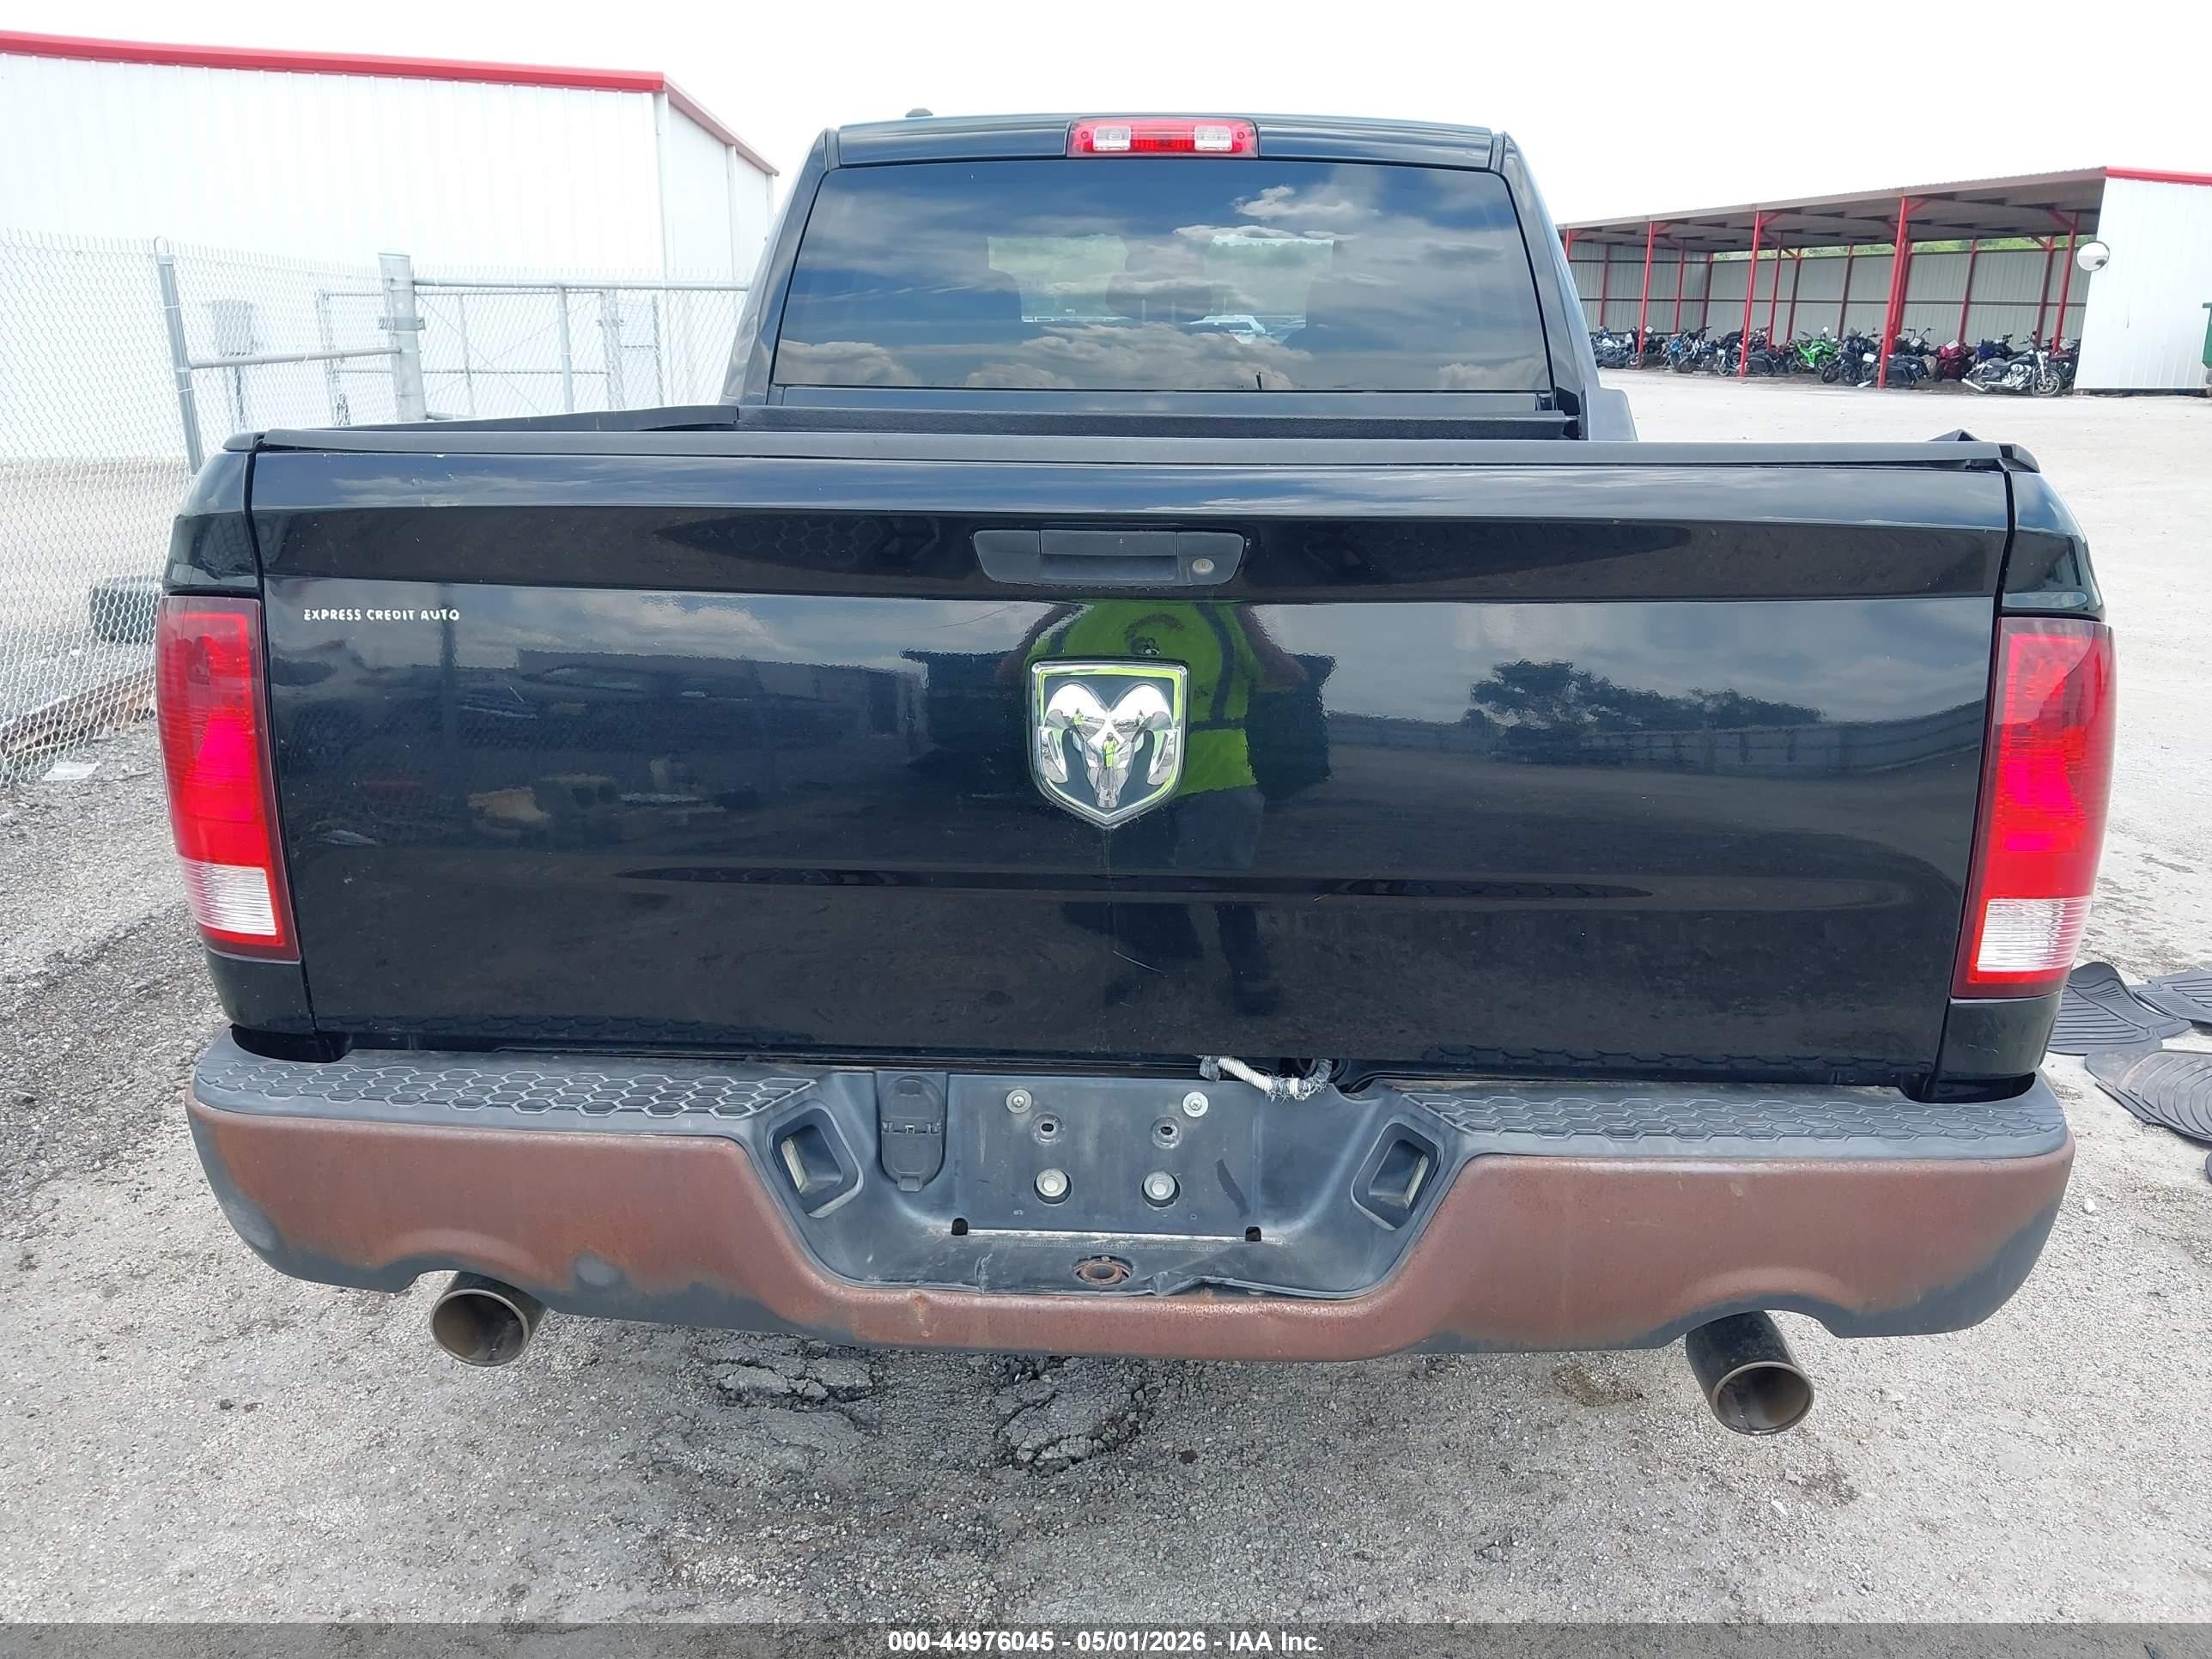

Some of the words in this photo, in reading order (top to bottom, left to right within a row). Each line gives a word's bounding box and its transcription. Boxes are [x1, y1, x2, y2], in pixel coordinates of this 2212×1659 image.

[303, 609, 362, 621] EXPRESS
[366, 609, 416, 621] CREDIT
[420, 609, 460, 621] AUTO
